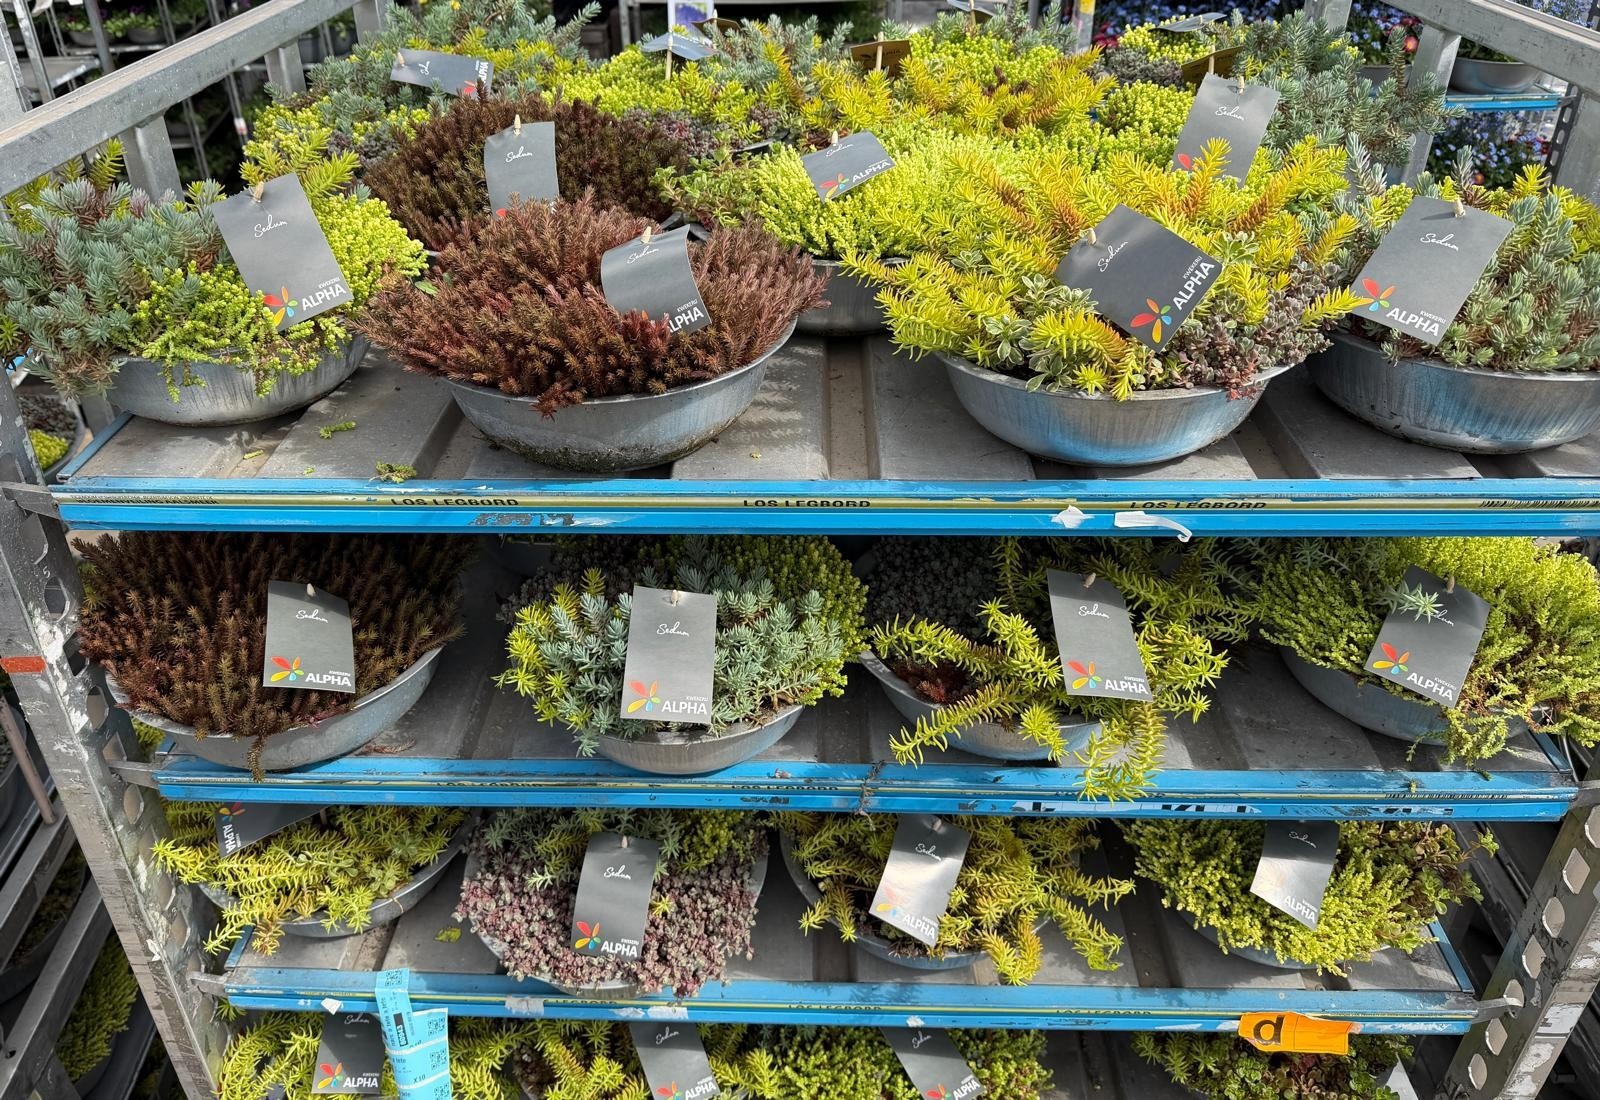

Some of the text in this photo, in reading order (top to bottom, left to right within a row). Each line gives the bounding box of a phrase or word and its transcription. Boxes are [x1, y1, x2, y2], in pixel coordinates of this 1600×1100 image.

[1215, 106, 1244, 120] Sedum
[506, 146, 532, 162] Sedum
[852, 161, 891, 183] ALPHA
[254, 214, 288, 238] Sedum
[1420, 233, 1459, 252] Sedum
[1098, 241, 1128, 272] Sedum
[1172, 261, 1215, 311] ALPHA
[301, 284, 346, 311] ALPHA
[1386, 308, 1440, 336] ALPHA
[391, 498, 427, 506] LOS
[744, 500, 871, 508] LOS LEGBORD
[1130, 502, 1267, 510] LOS LEGBORD
[296, 608, 328, 624] Sedum
[1078, 604, 1110, 619] Sedum
[656, 622, 690, 637] Sedum
[305, 672, 352, 686] ALPHA
[1104, 680, 1148, 695] ALPHA
[1406, 672, 1454, 700] ALPHA
[662, 700, 708, 715] ALPHA
[222, 824, 236, 854] ALPHA
[915, 844, 942, 861] Sedum
[604, 864, 632, 880] Sedum
[1284, 895, 1316, 924] ALPHA
[903, 914, 935, 940] ALPHA
[601, 940, 638, 958] ALPHA
[344, 1014, 370, 1025] Sedum
[656, 1026, 680, 1045] Sedum
[1253, 1014, 1285, 1046] d
[343, 1077, 378, 1088] ALPHA
[684, 1081, 717, 1100] ALPHA
[952, 1079, 980, 1100] ALPHA
